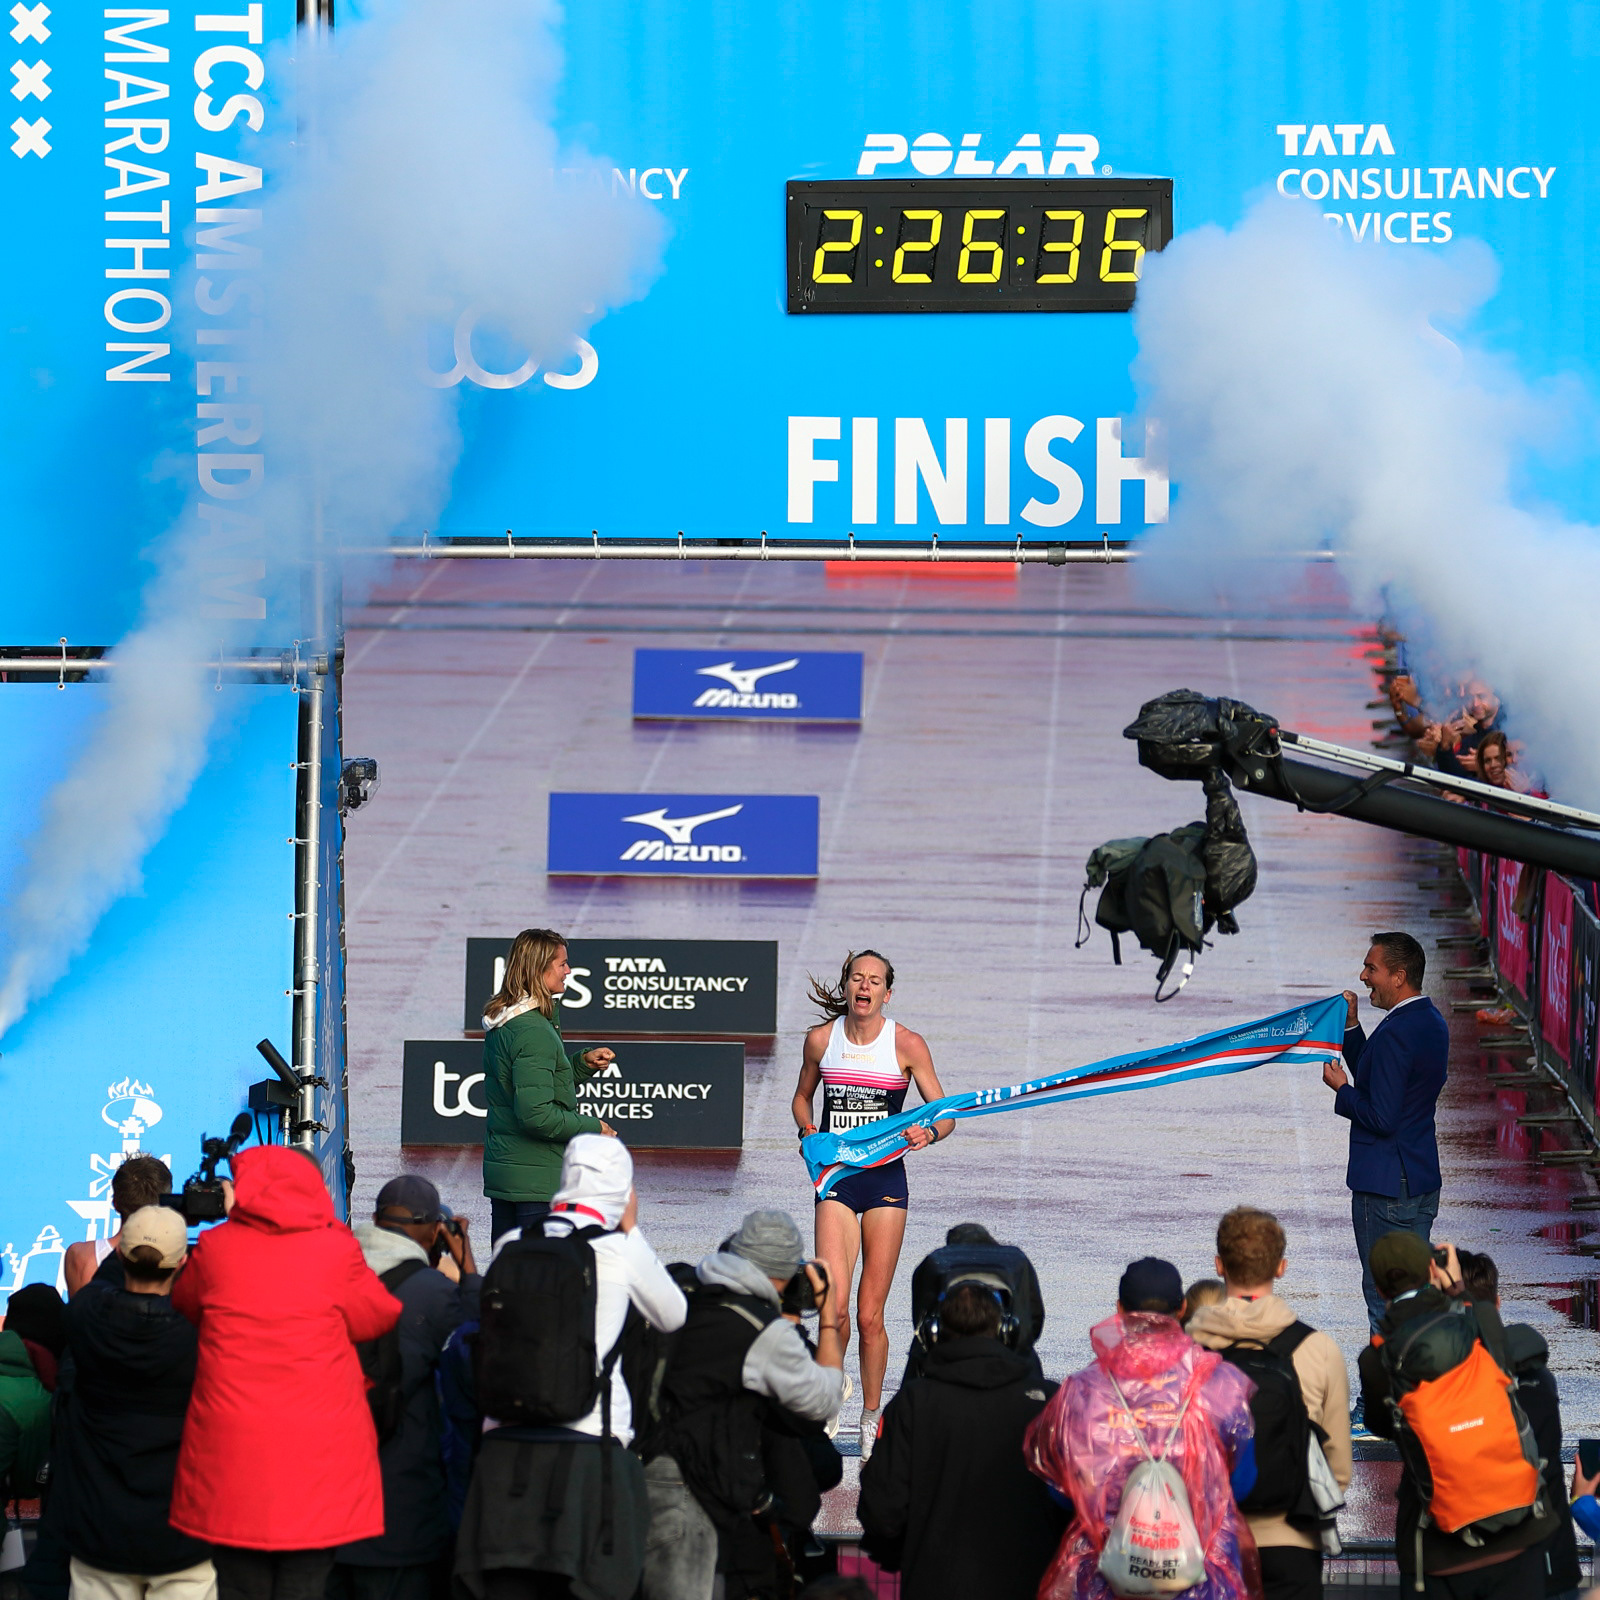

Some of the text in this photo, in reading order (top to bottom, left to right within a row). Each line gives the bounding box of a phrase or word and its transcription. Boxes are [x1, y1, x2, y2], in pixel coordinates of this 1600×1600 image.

[194, 3, 265, 132] TCS
[1276, 124, 1396, 156] TATA
[857, 132, 1100, 176] POLAR
[104, 8, 172, 382] MARATHON
[1276, 167, 1557, 200] CONSULTANCY
[812, 208, 1150, 284] 2:26:36
[787, 415, 1170, 528] FINISH
[693, 688, 799, 709] MIZUNO
[619, 839, 742, 863] MIZUNO
[605, 957, 667, 973] TATA
[604, 976, 749, 993] CONSULTANCY
[603, 994, 697, 1011] SERVICES
[846, 1086, 888, 1096] RUNNERS
[846, 1092, 876, 1100] WORLD
[1129, 1564, 1177, 1580] ROCK!
